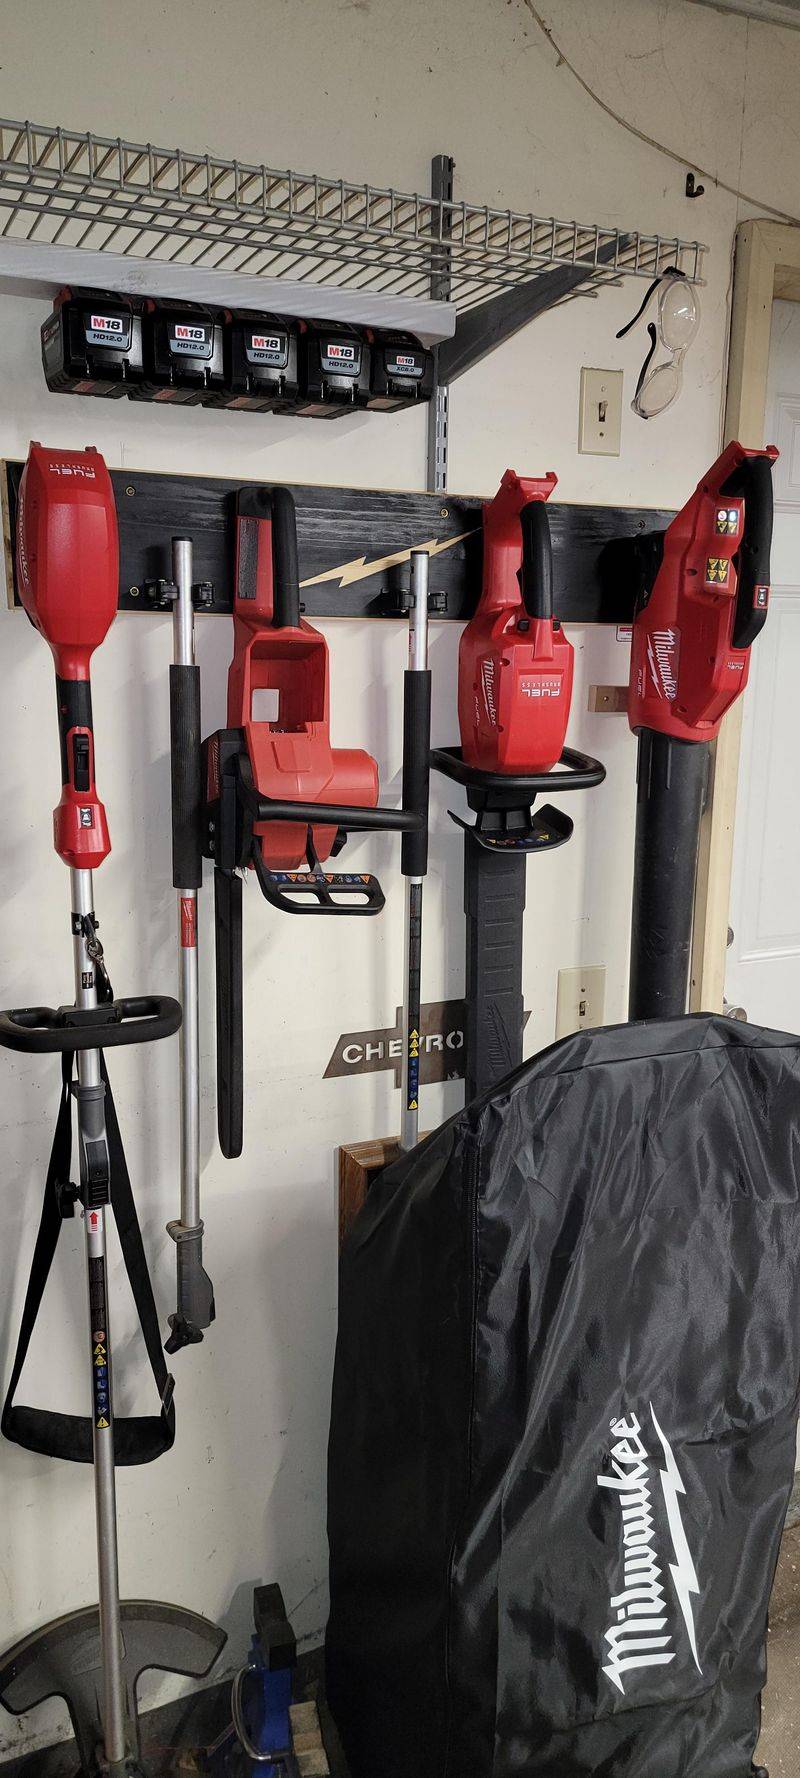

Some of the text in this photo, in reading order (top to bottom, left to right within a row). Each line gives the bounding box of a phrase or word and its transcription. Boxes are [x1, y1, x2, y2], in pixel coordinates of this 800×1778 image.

[93, 318, 121, 330] M18
[93, 333, 123, 343] HD12.0
[176, 327, 203, 339] M18
[176, 342, 205, 351] HD12.0
[253, 337, 279, 348] M18
[253, 352, 280, 360] HD12.0
[328, 346, 353, 358] M18
[328, 361, 354, 369] HD12.0
[397, 357, 413, 365] M18
[49, 468, 96, 478] FUEL
[651, 628, 677, 700] Milwaukee
[482, 658, 497, 727] Milwaukee
[521, 688, 560, 698] FUEL
[342, 1030, 464, 1064] CHERO
[596, 1411, 677, 1696] Milwaukee
